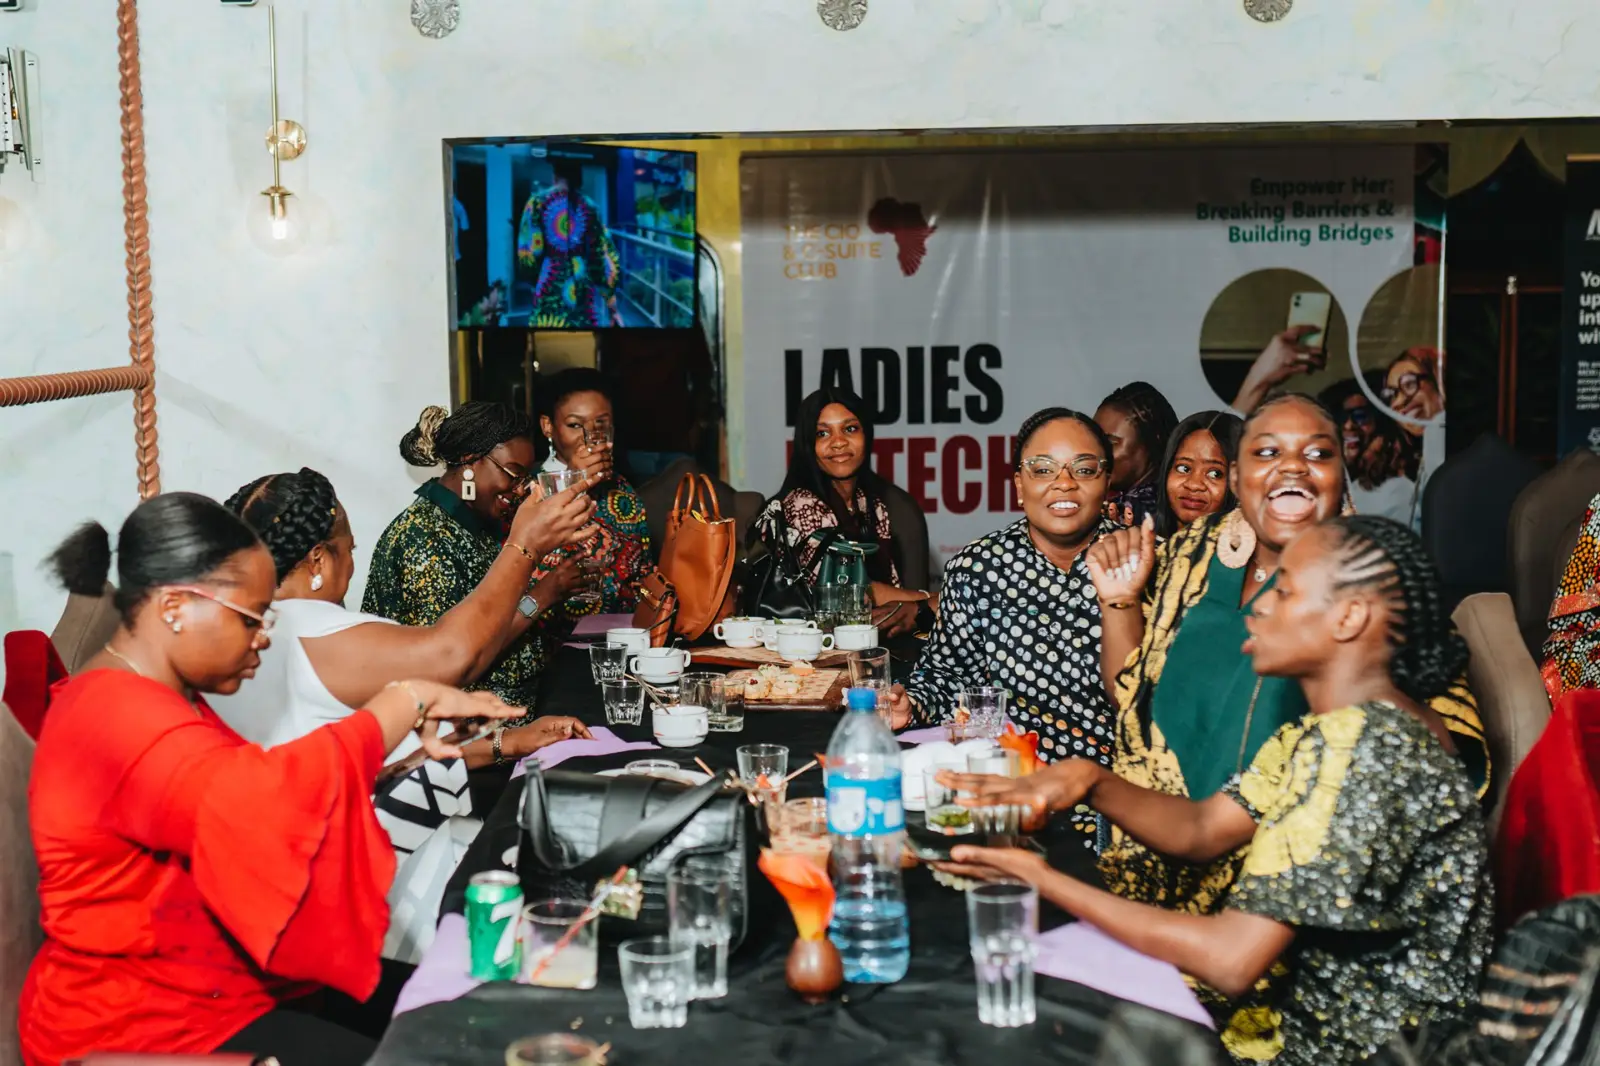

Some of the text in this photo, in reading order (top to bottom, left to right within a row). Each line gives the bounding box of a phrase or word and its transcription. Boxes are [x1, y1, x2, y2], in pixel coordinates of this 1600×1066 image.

[1251, 178, 1346, 199] Empower
[1196, 199, 1394, 223] Breaking Barriers &
[825, 223, 861, 240] CIO
[1228, 222, 1394, 247] Building Bridges
[784, 262, 838, 280] CLUB
